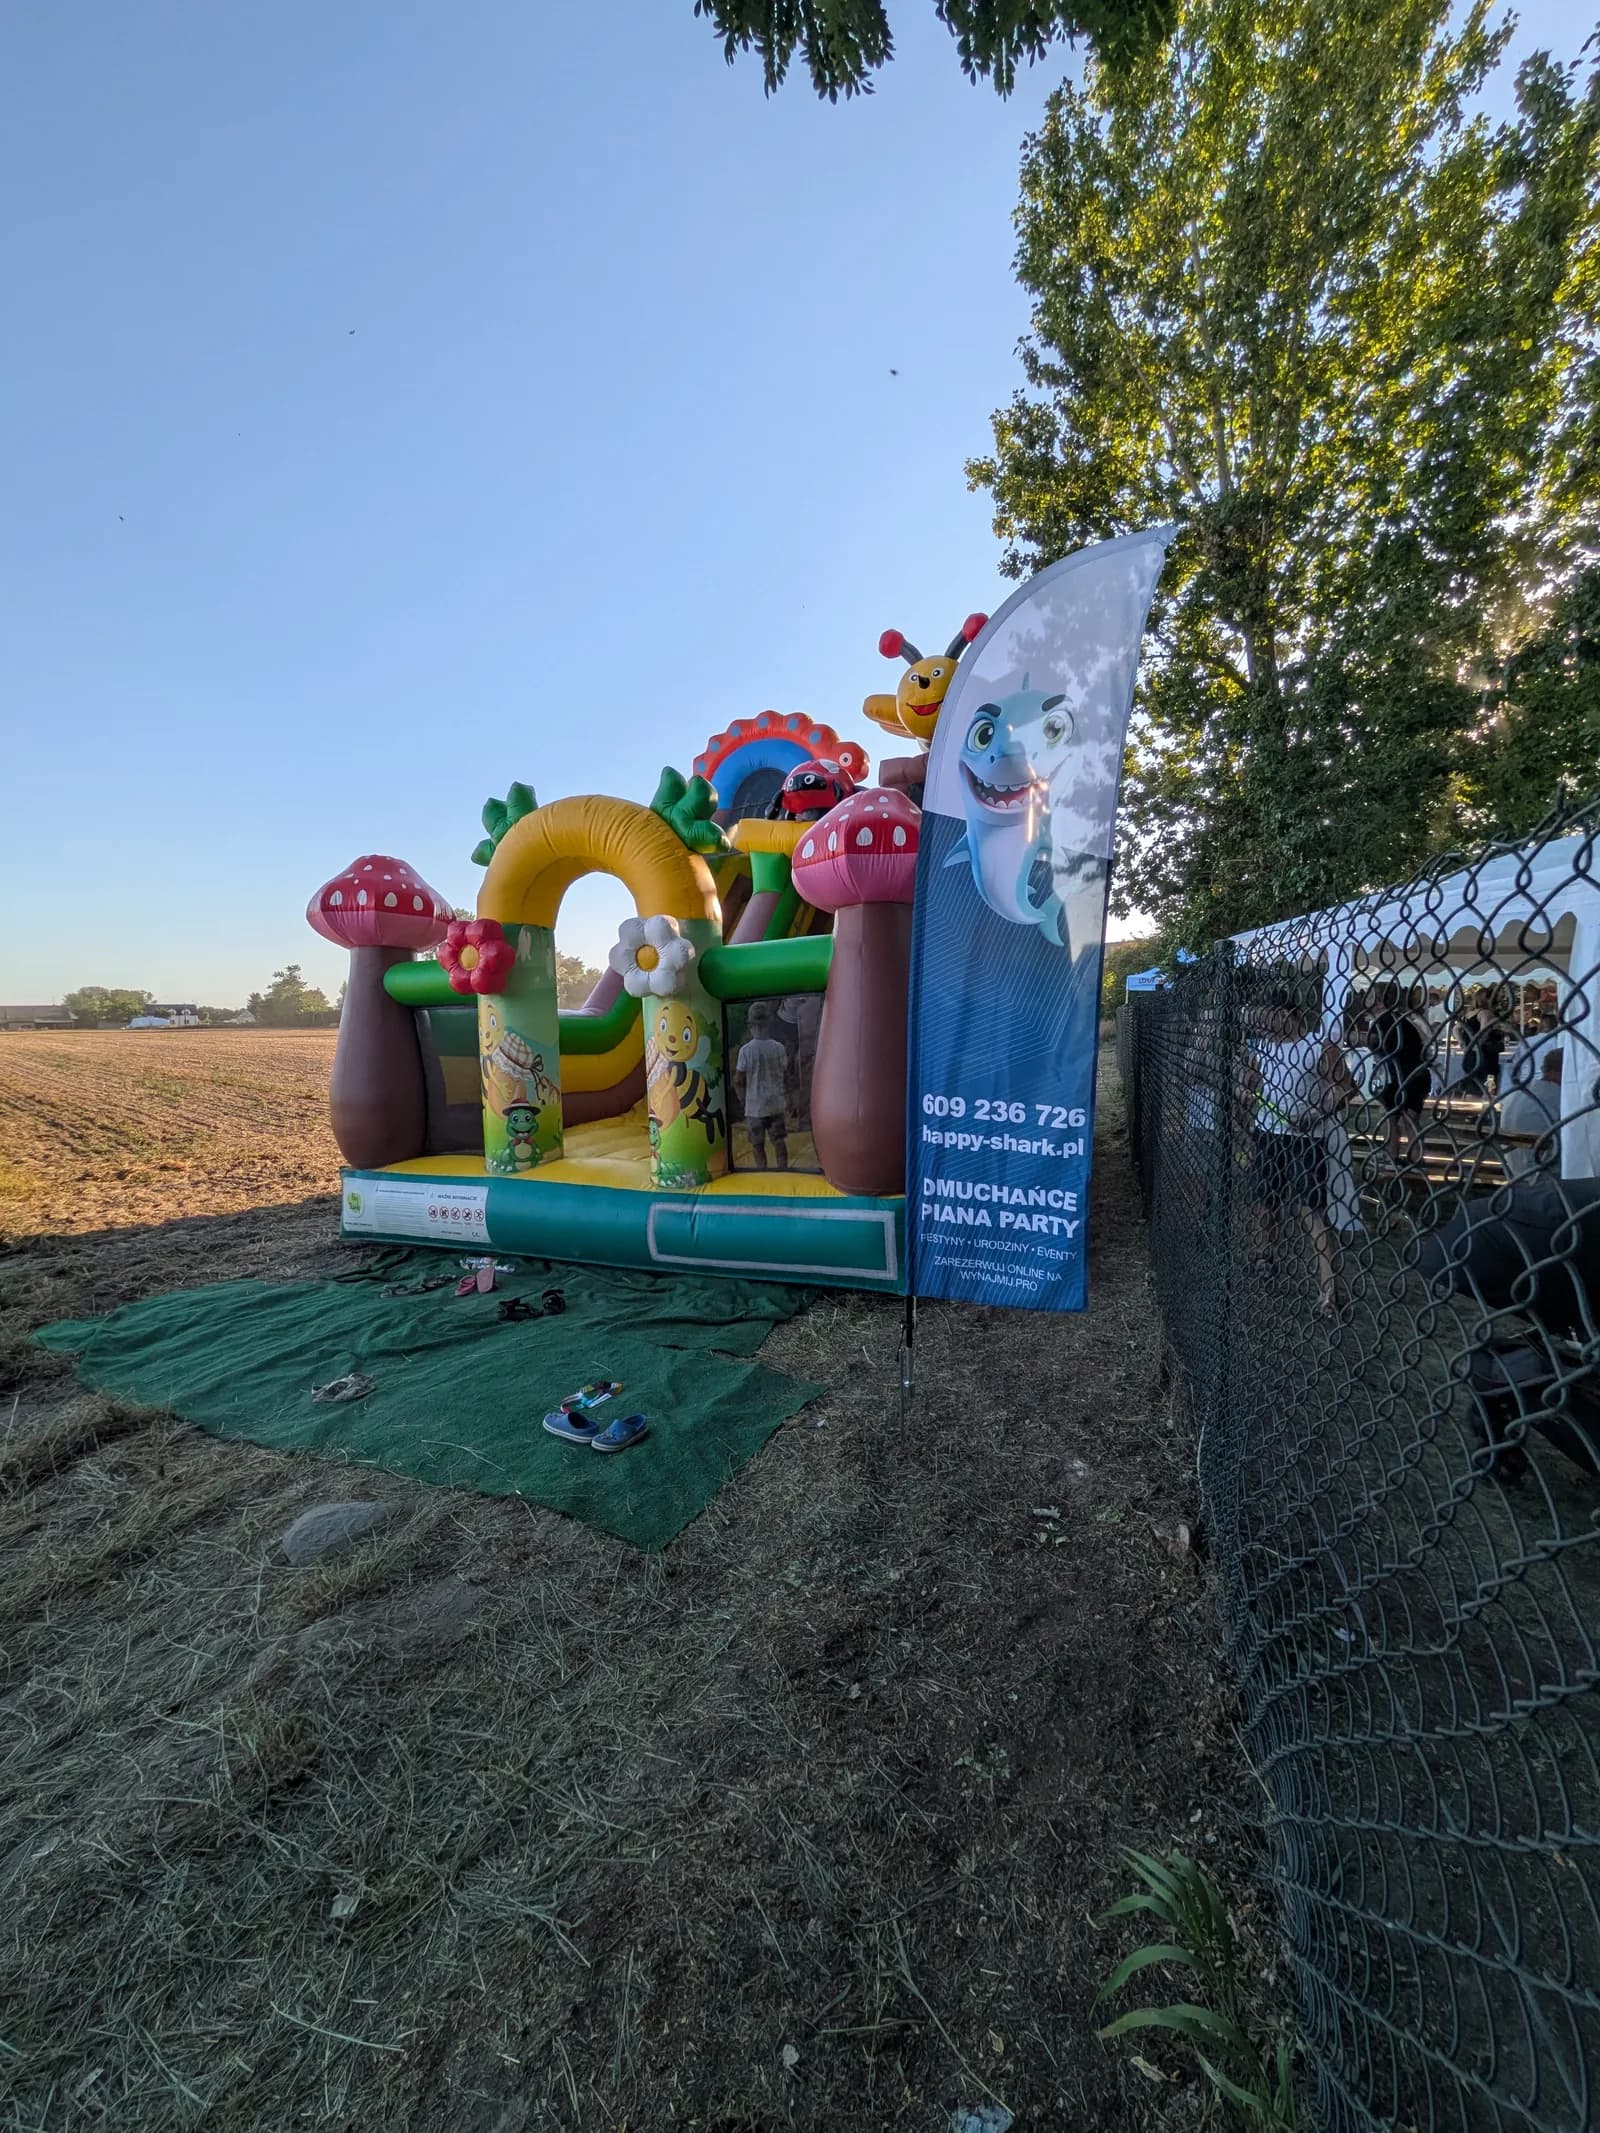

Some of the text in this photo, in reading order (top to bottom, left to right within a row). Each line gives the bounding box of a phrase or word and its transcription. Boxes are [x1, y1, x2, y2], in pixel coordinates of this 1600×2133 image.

[922, 1094, 1086, 1129] 609 236 726
[922, 1125, 1084, 1158] happy-shark.pl
[923, 1178, 1078, 1212] DMUCHAŃCE
[921, 1203, 1080, 1239] PIANA PARTY
[920, 1233, 1078, 1261] FESTYNY URODZINY EVENTY
[934, 1256, 1062, 1282] ZAREZERWUJ ONLINE NA
[960, 1270, 1038, 1291] WYNAJMIJ.PRO
